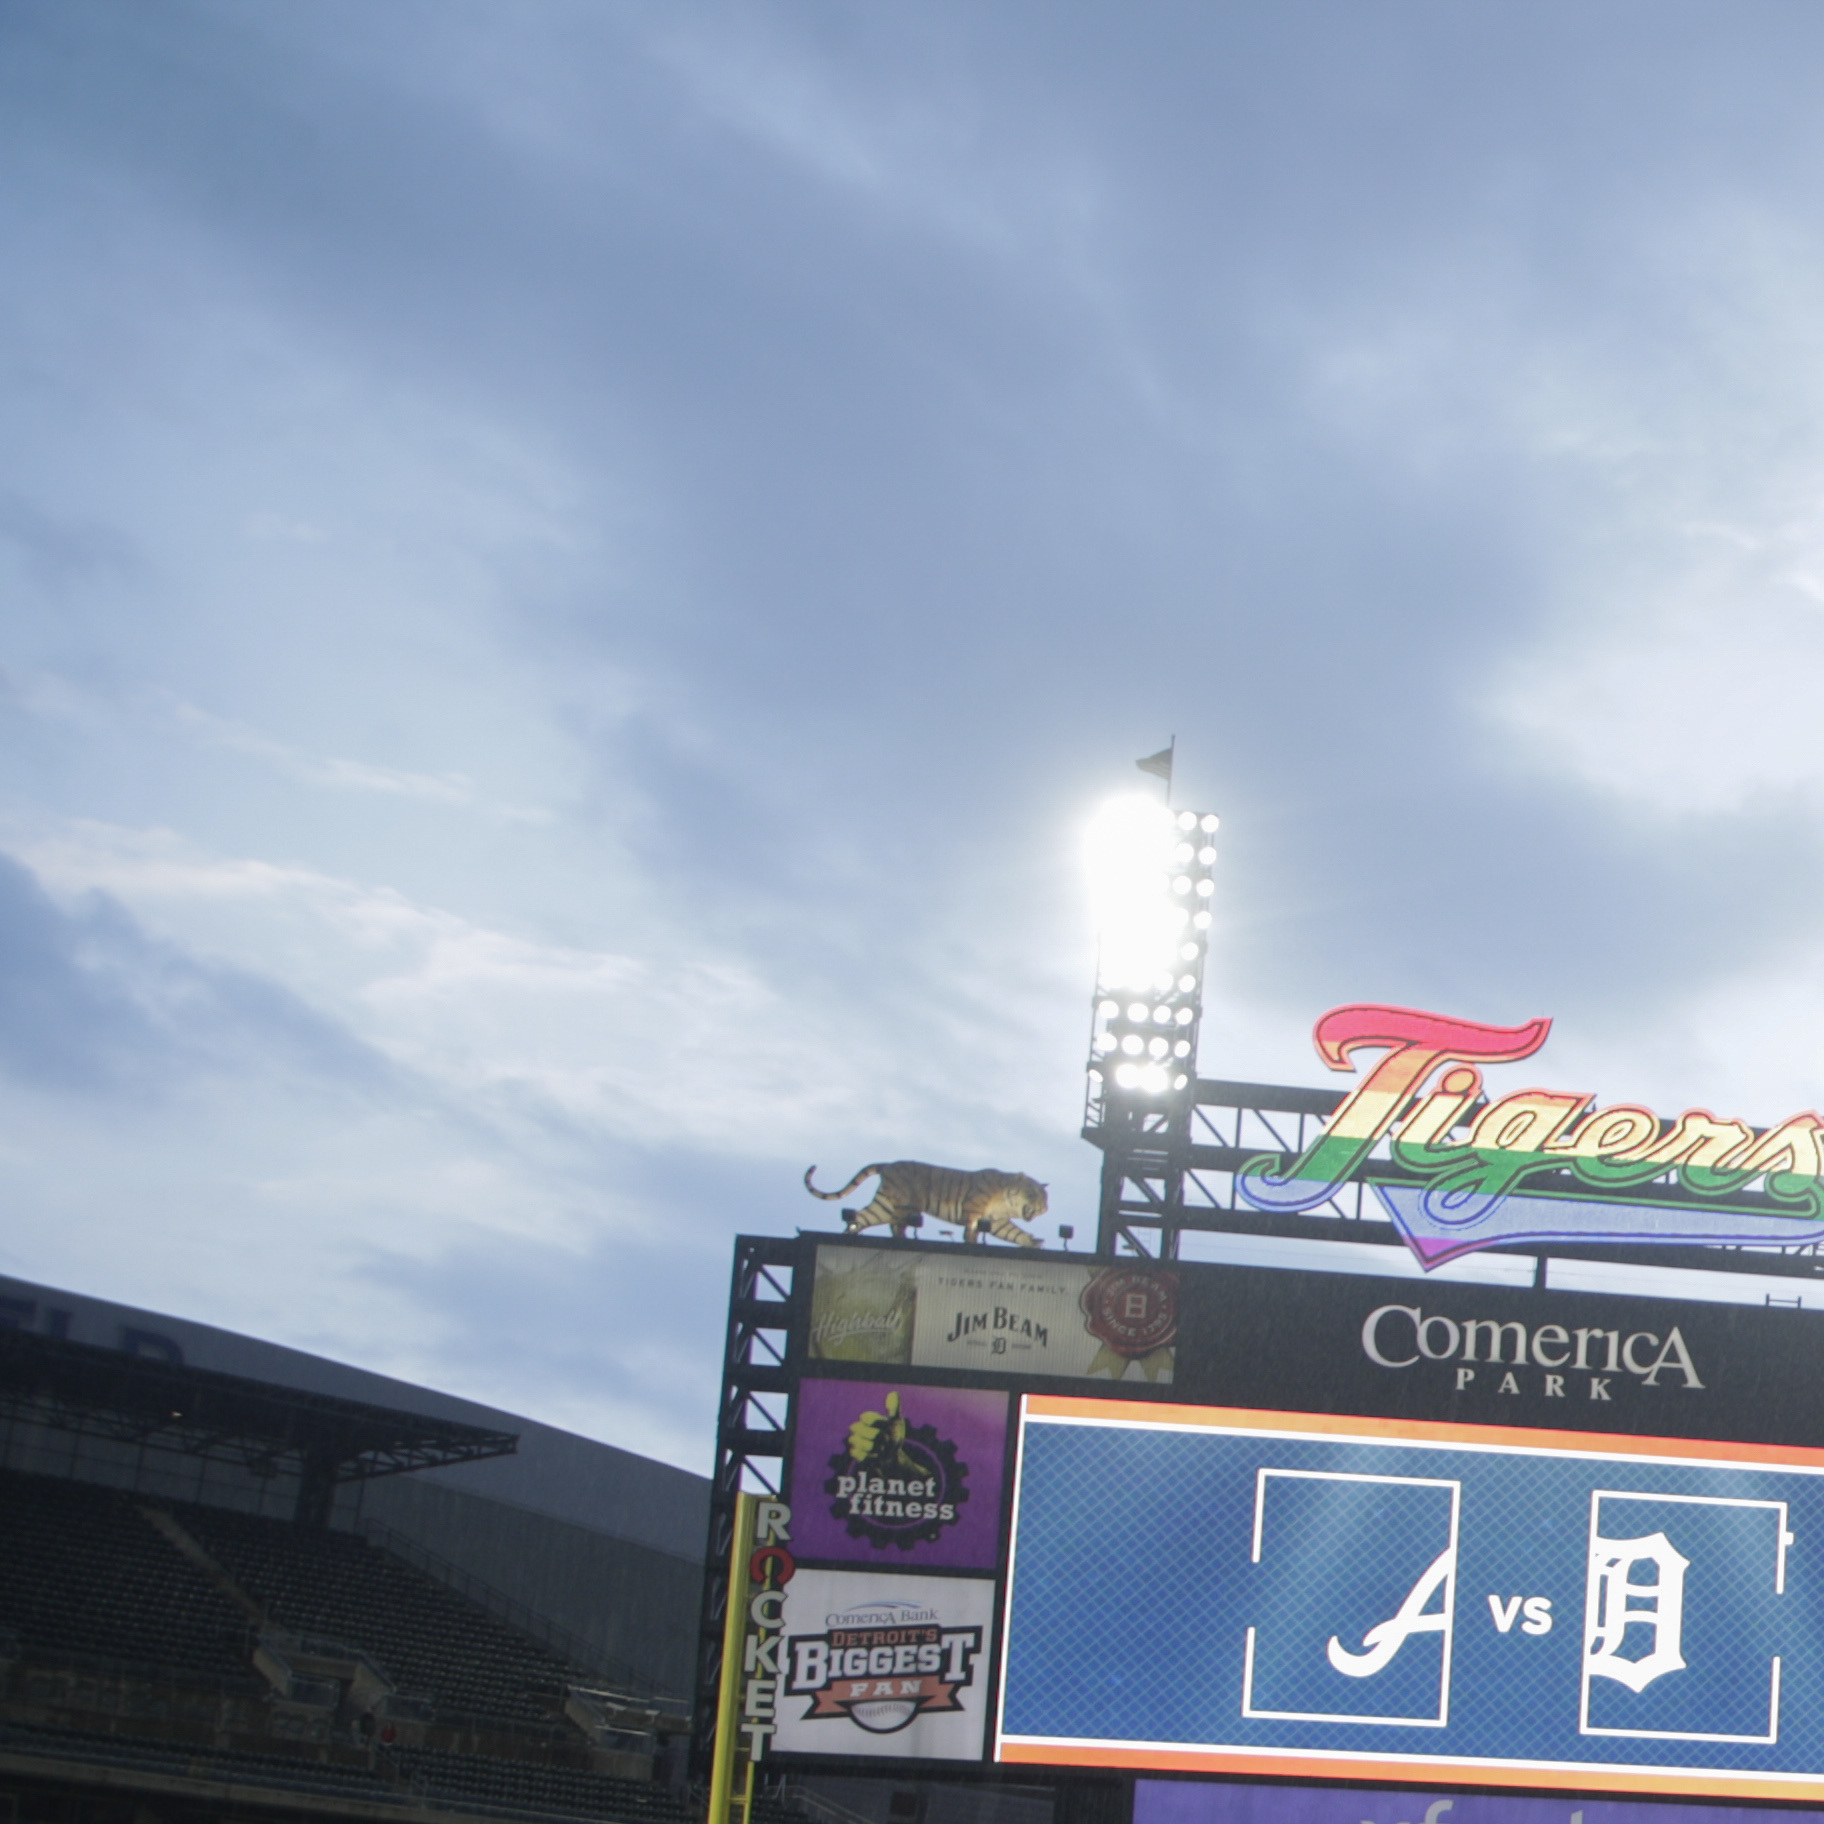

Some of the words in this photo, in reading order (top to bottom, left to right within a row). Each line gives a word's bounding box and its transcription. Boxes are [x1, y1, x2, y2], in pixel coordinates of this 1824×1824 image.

[947, 1311, 988, 1342] JIM
[993, 1306, 1049, 1348] BEAM
[1455, 1369, 1613, 1401] PARK
[836, 1471, 937, 1499] planet
[848, 1493, 955, 1521] fitness
[900, 1608, 940, 1622] Bank
[740, 1501, 797, 1763] ROCKET
[831, 1628, 938, 1648] DETROIT'S
[791, 1632, 976, 1690] BIGGEST
[850, 1680, 923, 1698] FAN
